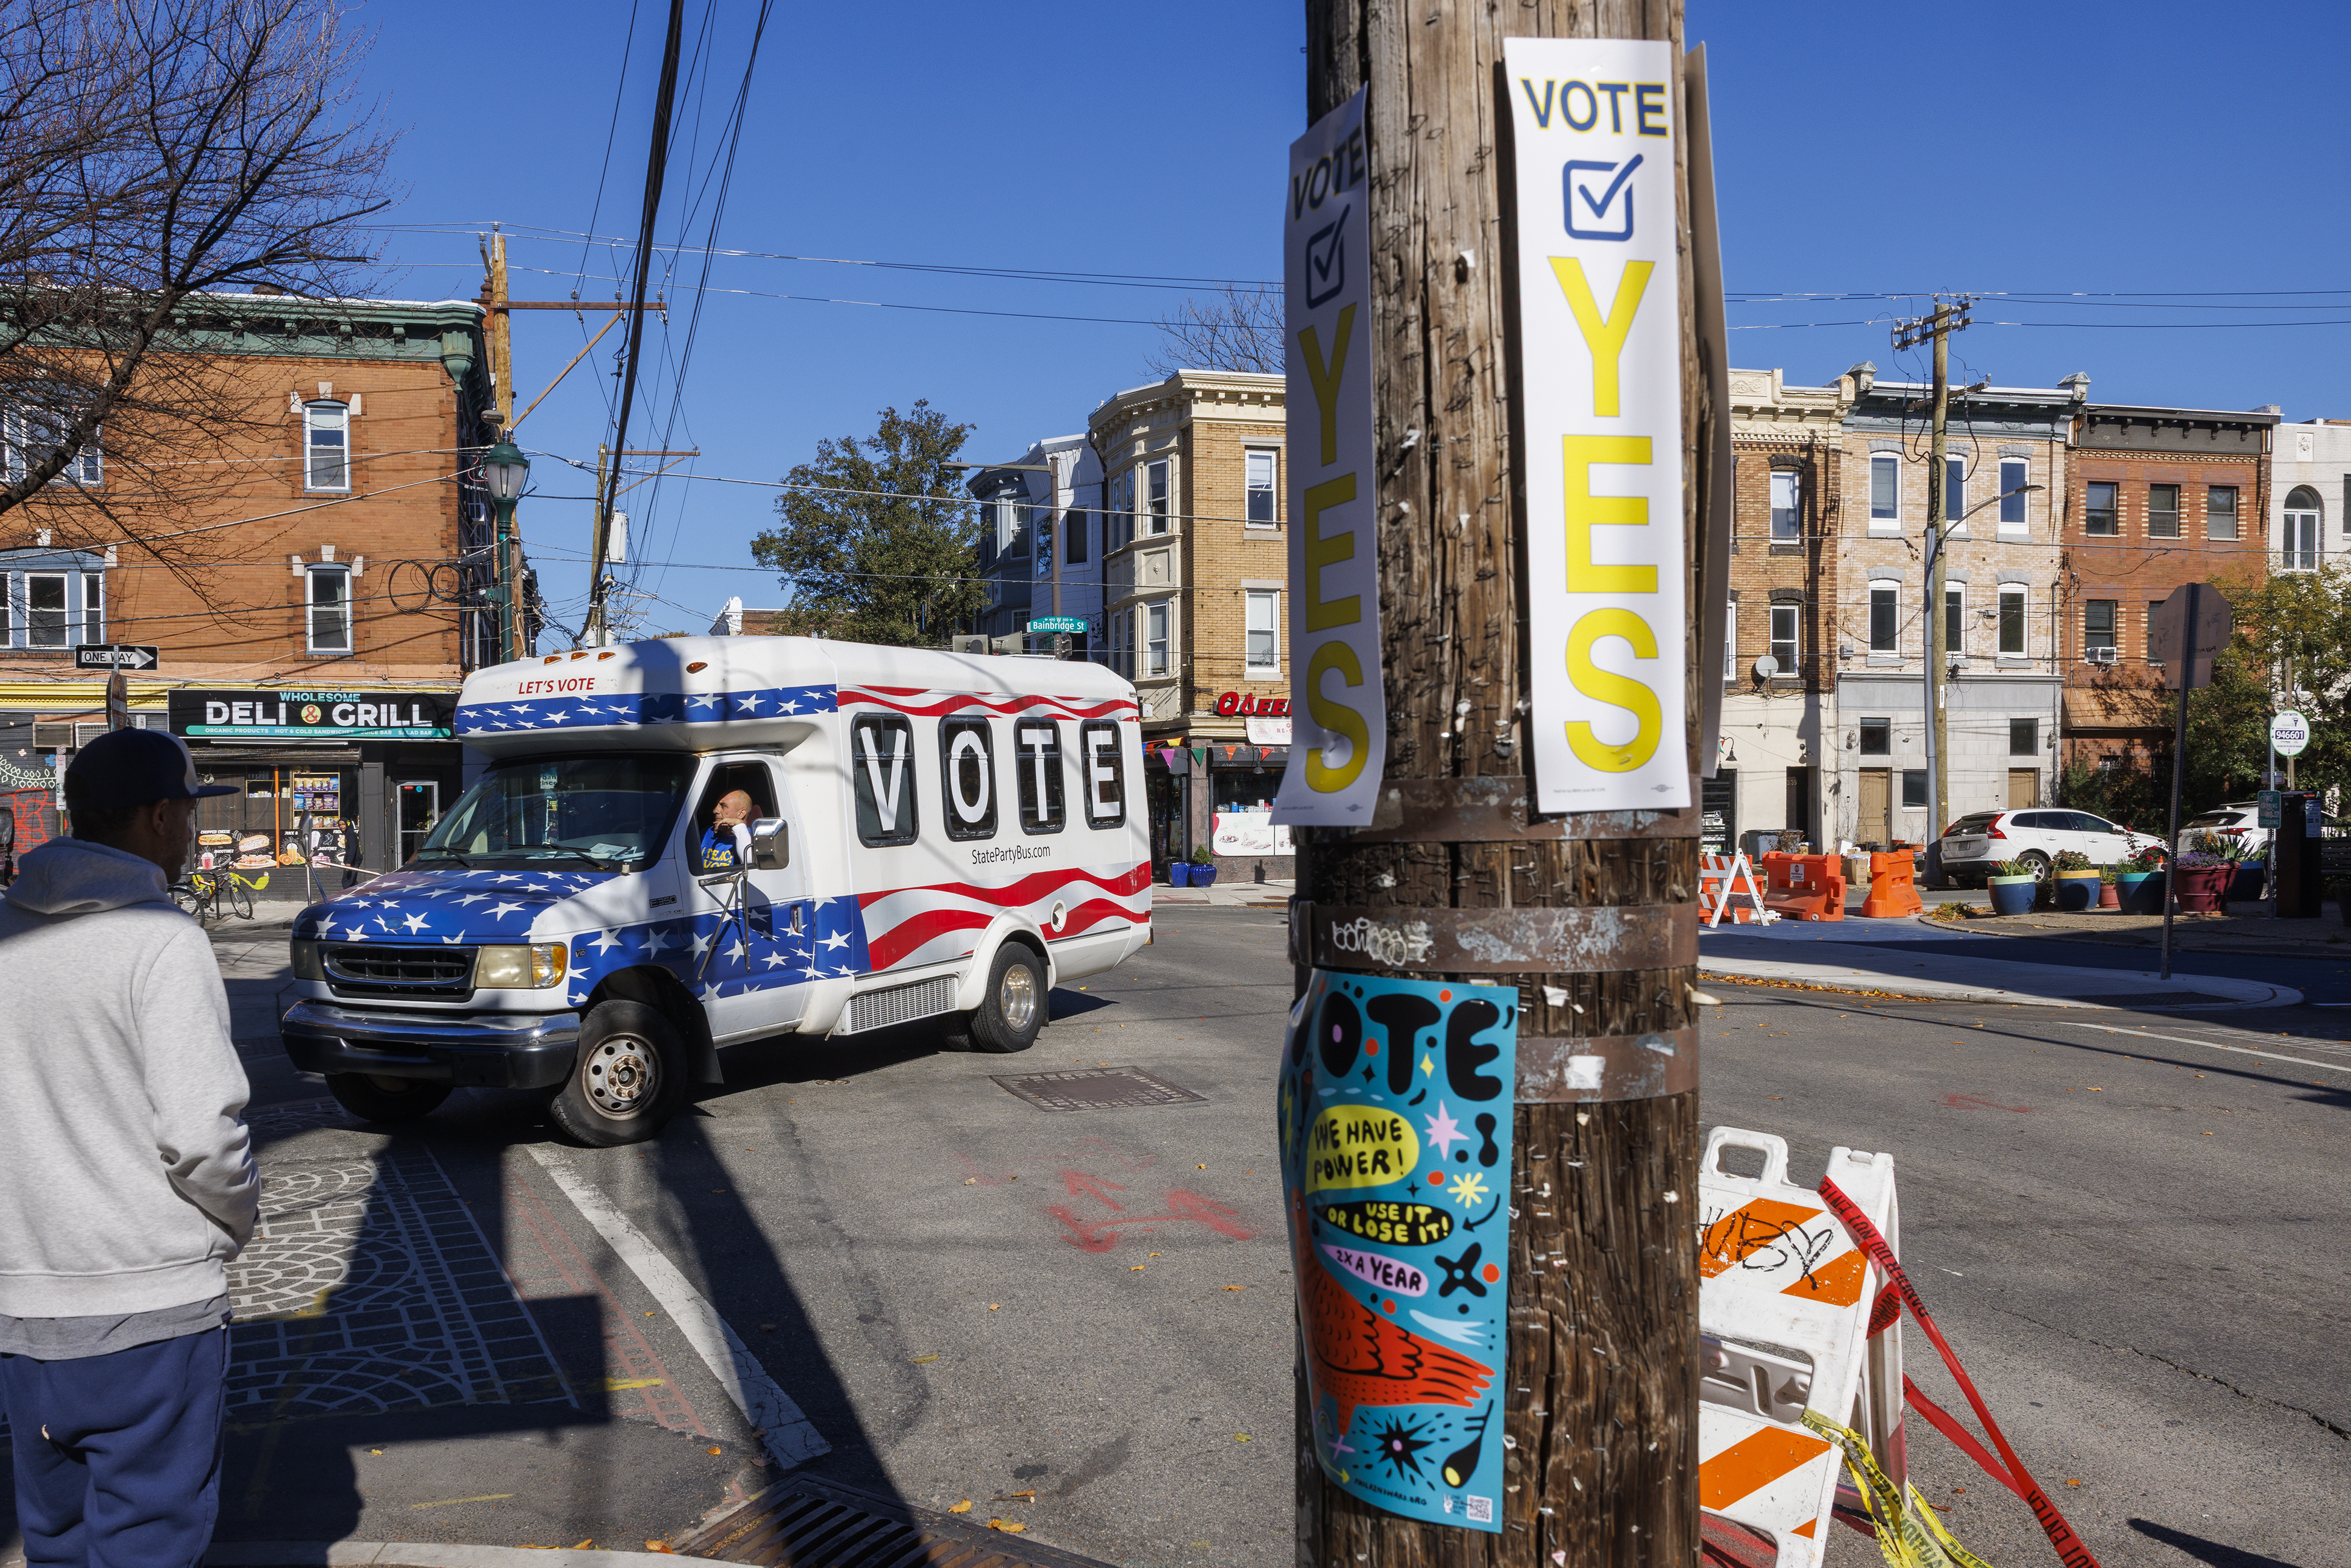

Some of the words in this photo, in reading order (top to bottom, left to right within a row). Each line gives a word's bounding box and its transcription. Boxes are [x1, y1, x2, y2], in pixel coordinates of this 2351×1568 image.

[1520, 77, 1669, 138] VOTE
[1292, 126, 1366, 222] VOTE
[1547, 256, 1663, 773] YES
[1298, 301, 1370, 793] YES
[1033, 621, 1074, 632] Bainbridge
[1077, 622, 1084, 630] St
[84, 652, 106, 662] ONE
[280, 692, 360, 702] WHOLESOME
[518, 680, 554, 694] LET'S
[558, 678, 595, 692] VOTE
[206, 701, 286, 725] DELI
[304, 705, 319, 723] &
[332, 703, 433, 727] GRILL
[2276, 731, 2303, 739] 946601
[860, 726, 1120, 831] VOTE
[972, 845, 1051, 865] StatePartyBus.com
[650, 896, 676, 907] E350
[1315, 1118, 1339, 1151] WE
[1346, 1118, 1402, 1145] HAVE
[1818, 1181, 1852, 1215] ENTE
[1328, 1207, 1346, 1228] OR
[1353, 1214, 1409, 1242] LOSE
[1419, 1216, 1449, 1243] IT!
[1365, 1203, 1399, 1220] USE
[1406, 1205, 1432, 1223] IT
[1335, 1250, 1354, 1266] 2X
[1355, 1256, 1365, 1274] A
[1370, 1256, 1422, 1292] YEAR
[2027, 1490, 2071, 1547] ENTER
[2062, 1546, 2094, 1568] OT
